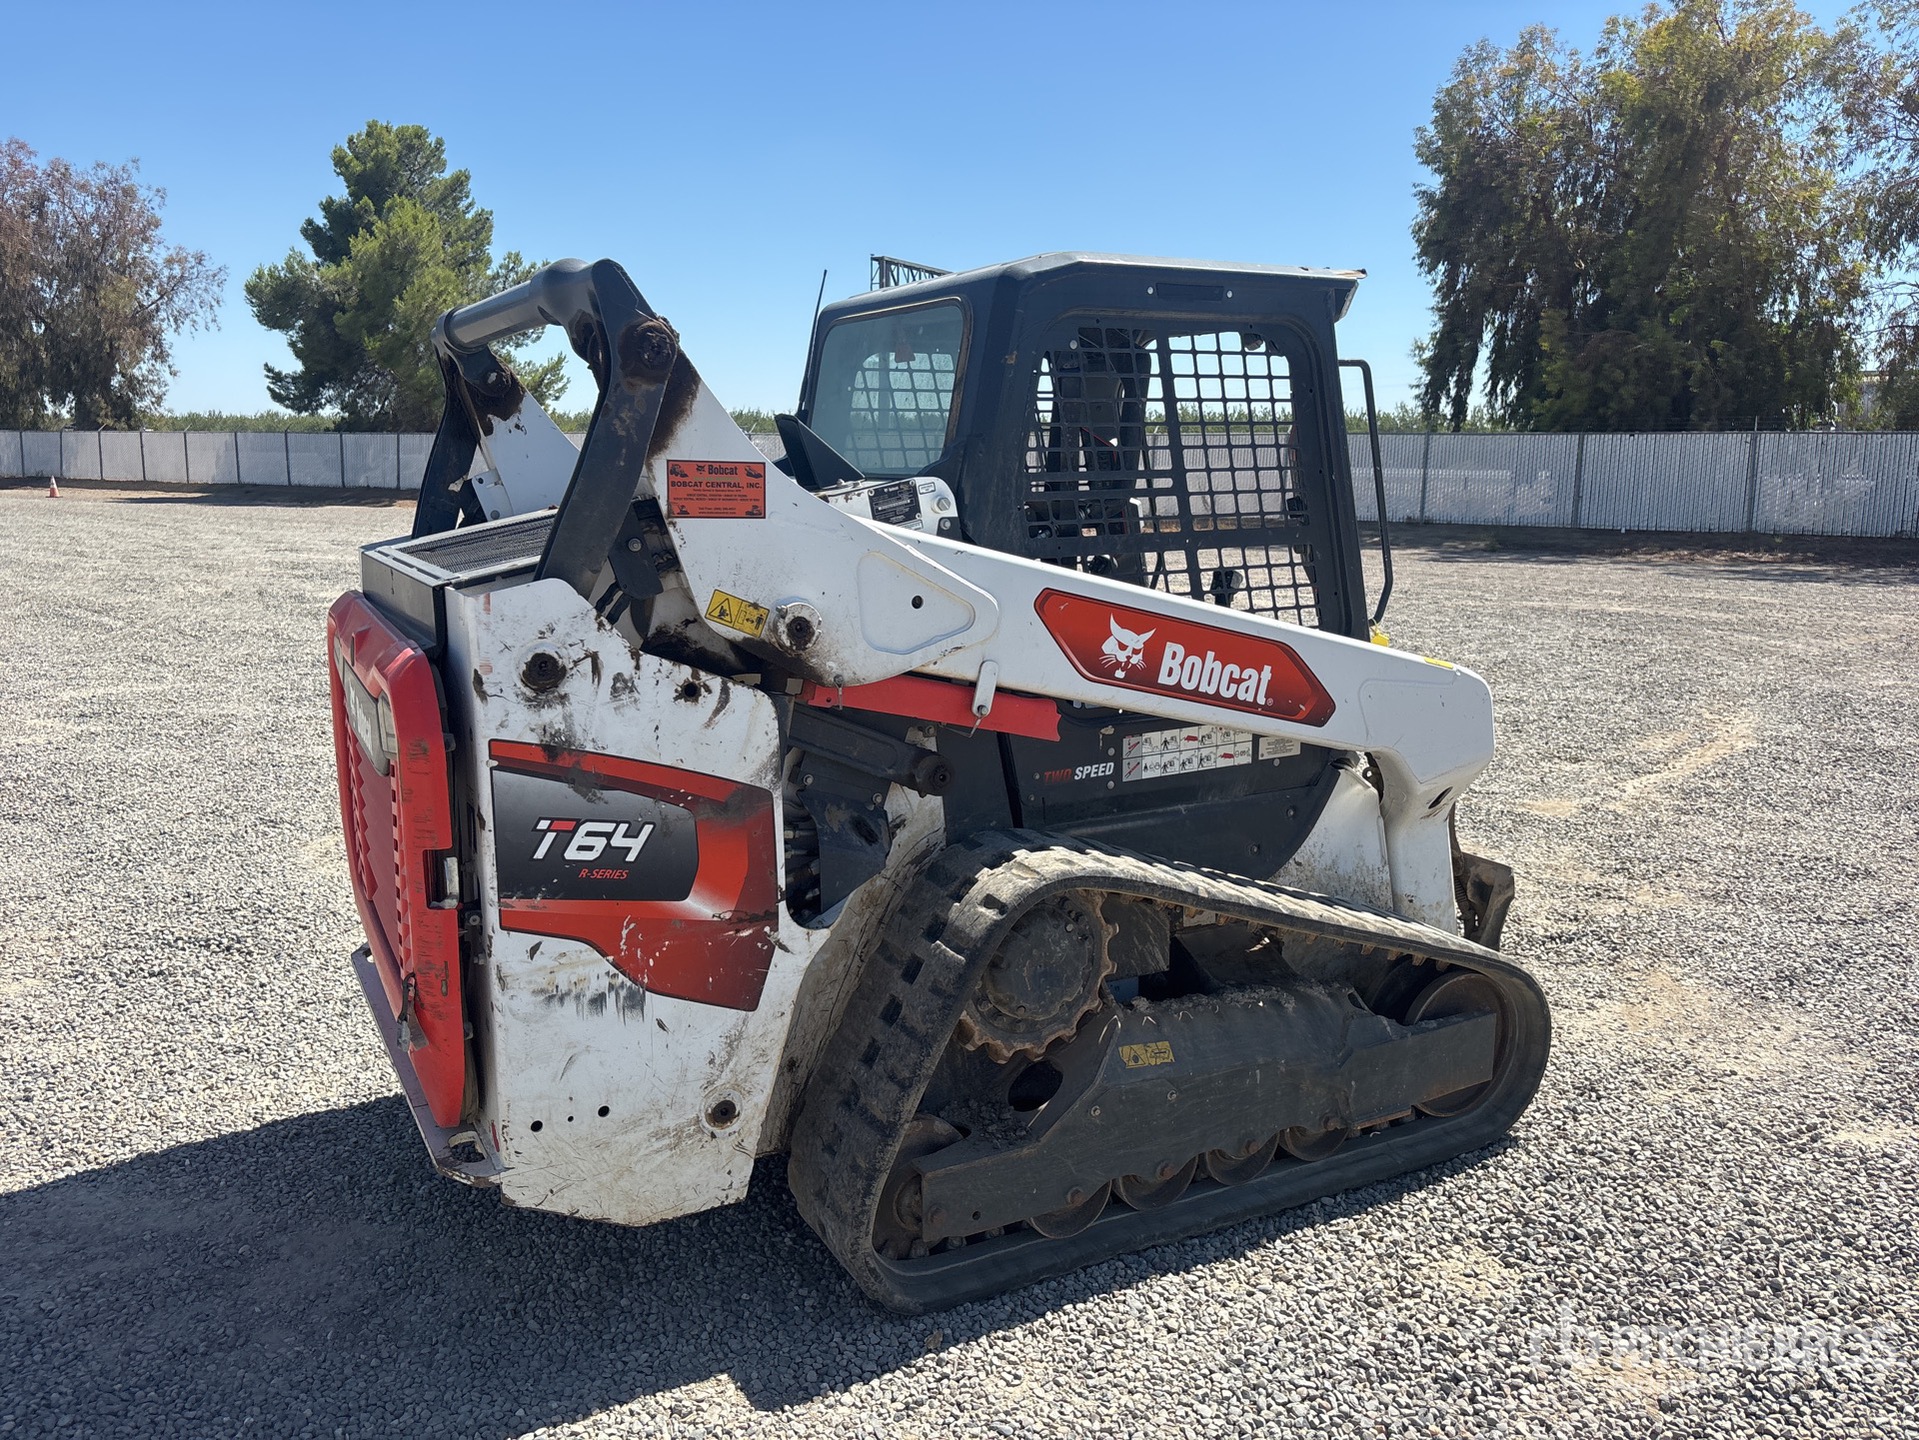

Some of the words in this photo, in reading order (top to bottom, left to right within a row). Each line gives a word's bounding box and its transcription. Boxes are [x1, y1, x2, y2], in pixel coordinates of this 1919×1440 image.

[707, 464, 738, 475] Bobcat
[705, 481, 744, 489] CENTRAL,
[1157, 641, 1272, 706] Bobcat
[1044, 770, 1072, 784] TWO
[1074, 762, 1115, 781] SPEED
[532, 819, 654, 862] T64
[578, 868, 629, 880] R-SERIES
